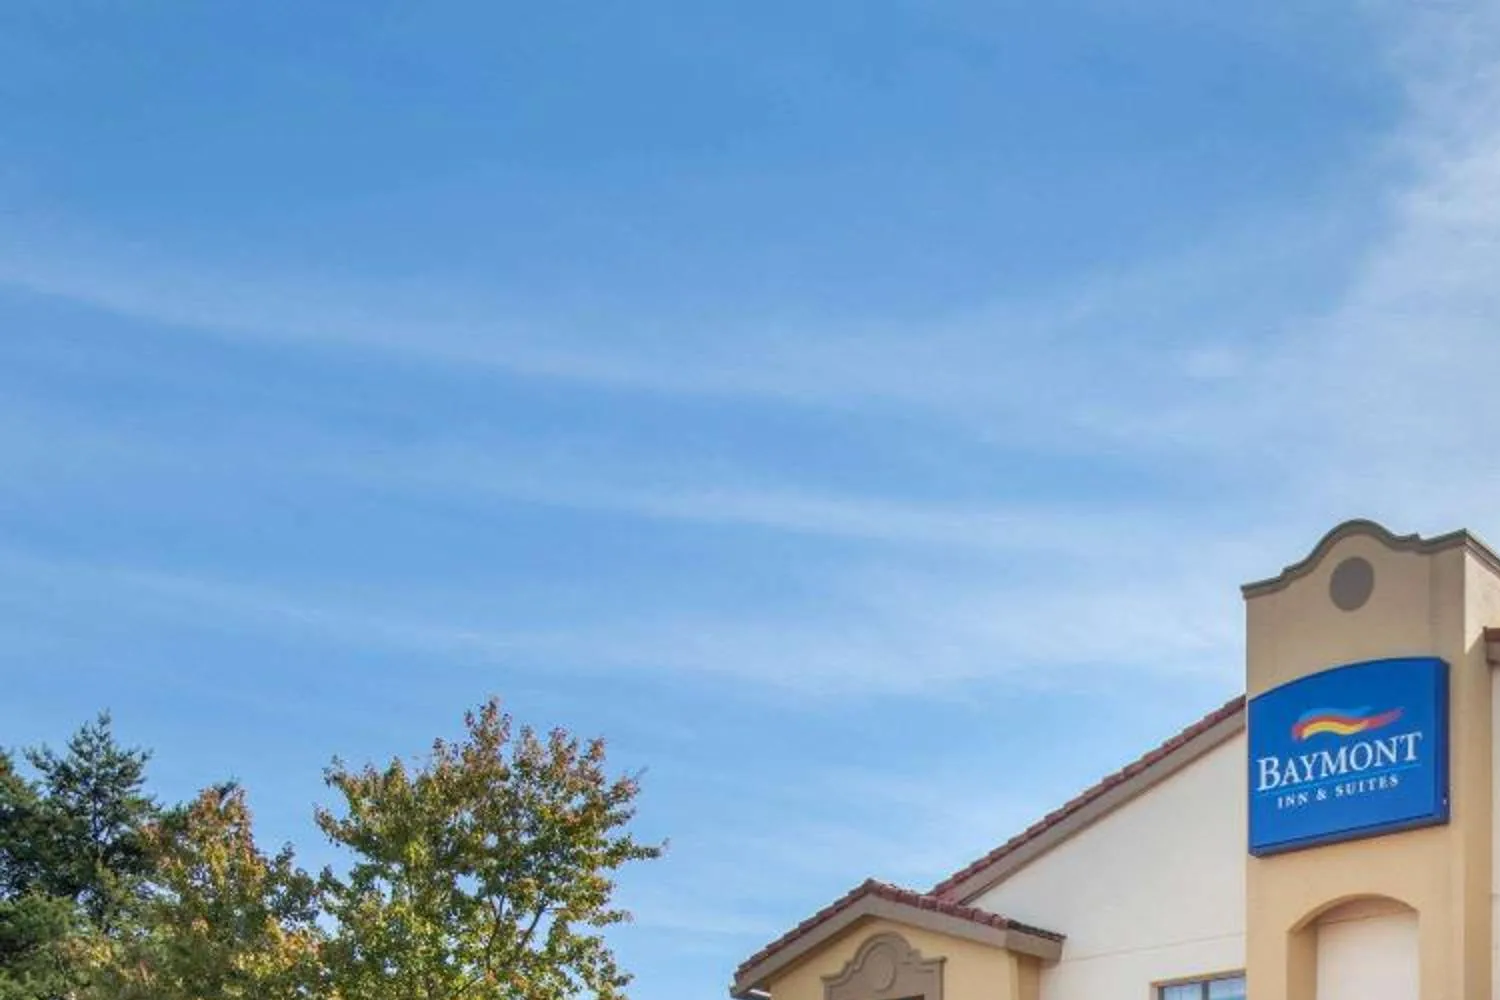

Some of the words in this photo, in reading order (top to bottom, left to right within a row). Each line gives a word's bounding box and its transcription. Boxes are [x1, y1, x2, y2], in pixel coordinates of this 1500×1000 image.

[1257, 731, 1423, 791] BAYMONT
[1277, 791, 1308, 809] INN
[1316, 787, 1328, 801] &
[1335, 773, 1399, 797] SUITES
